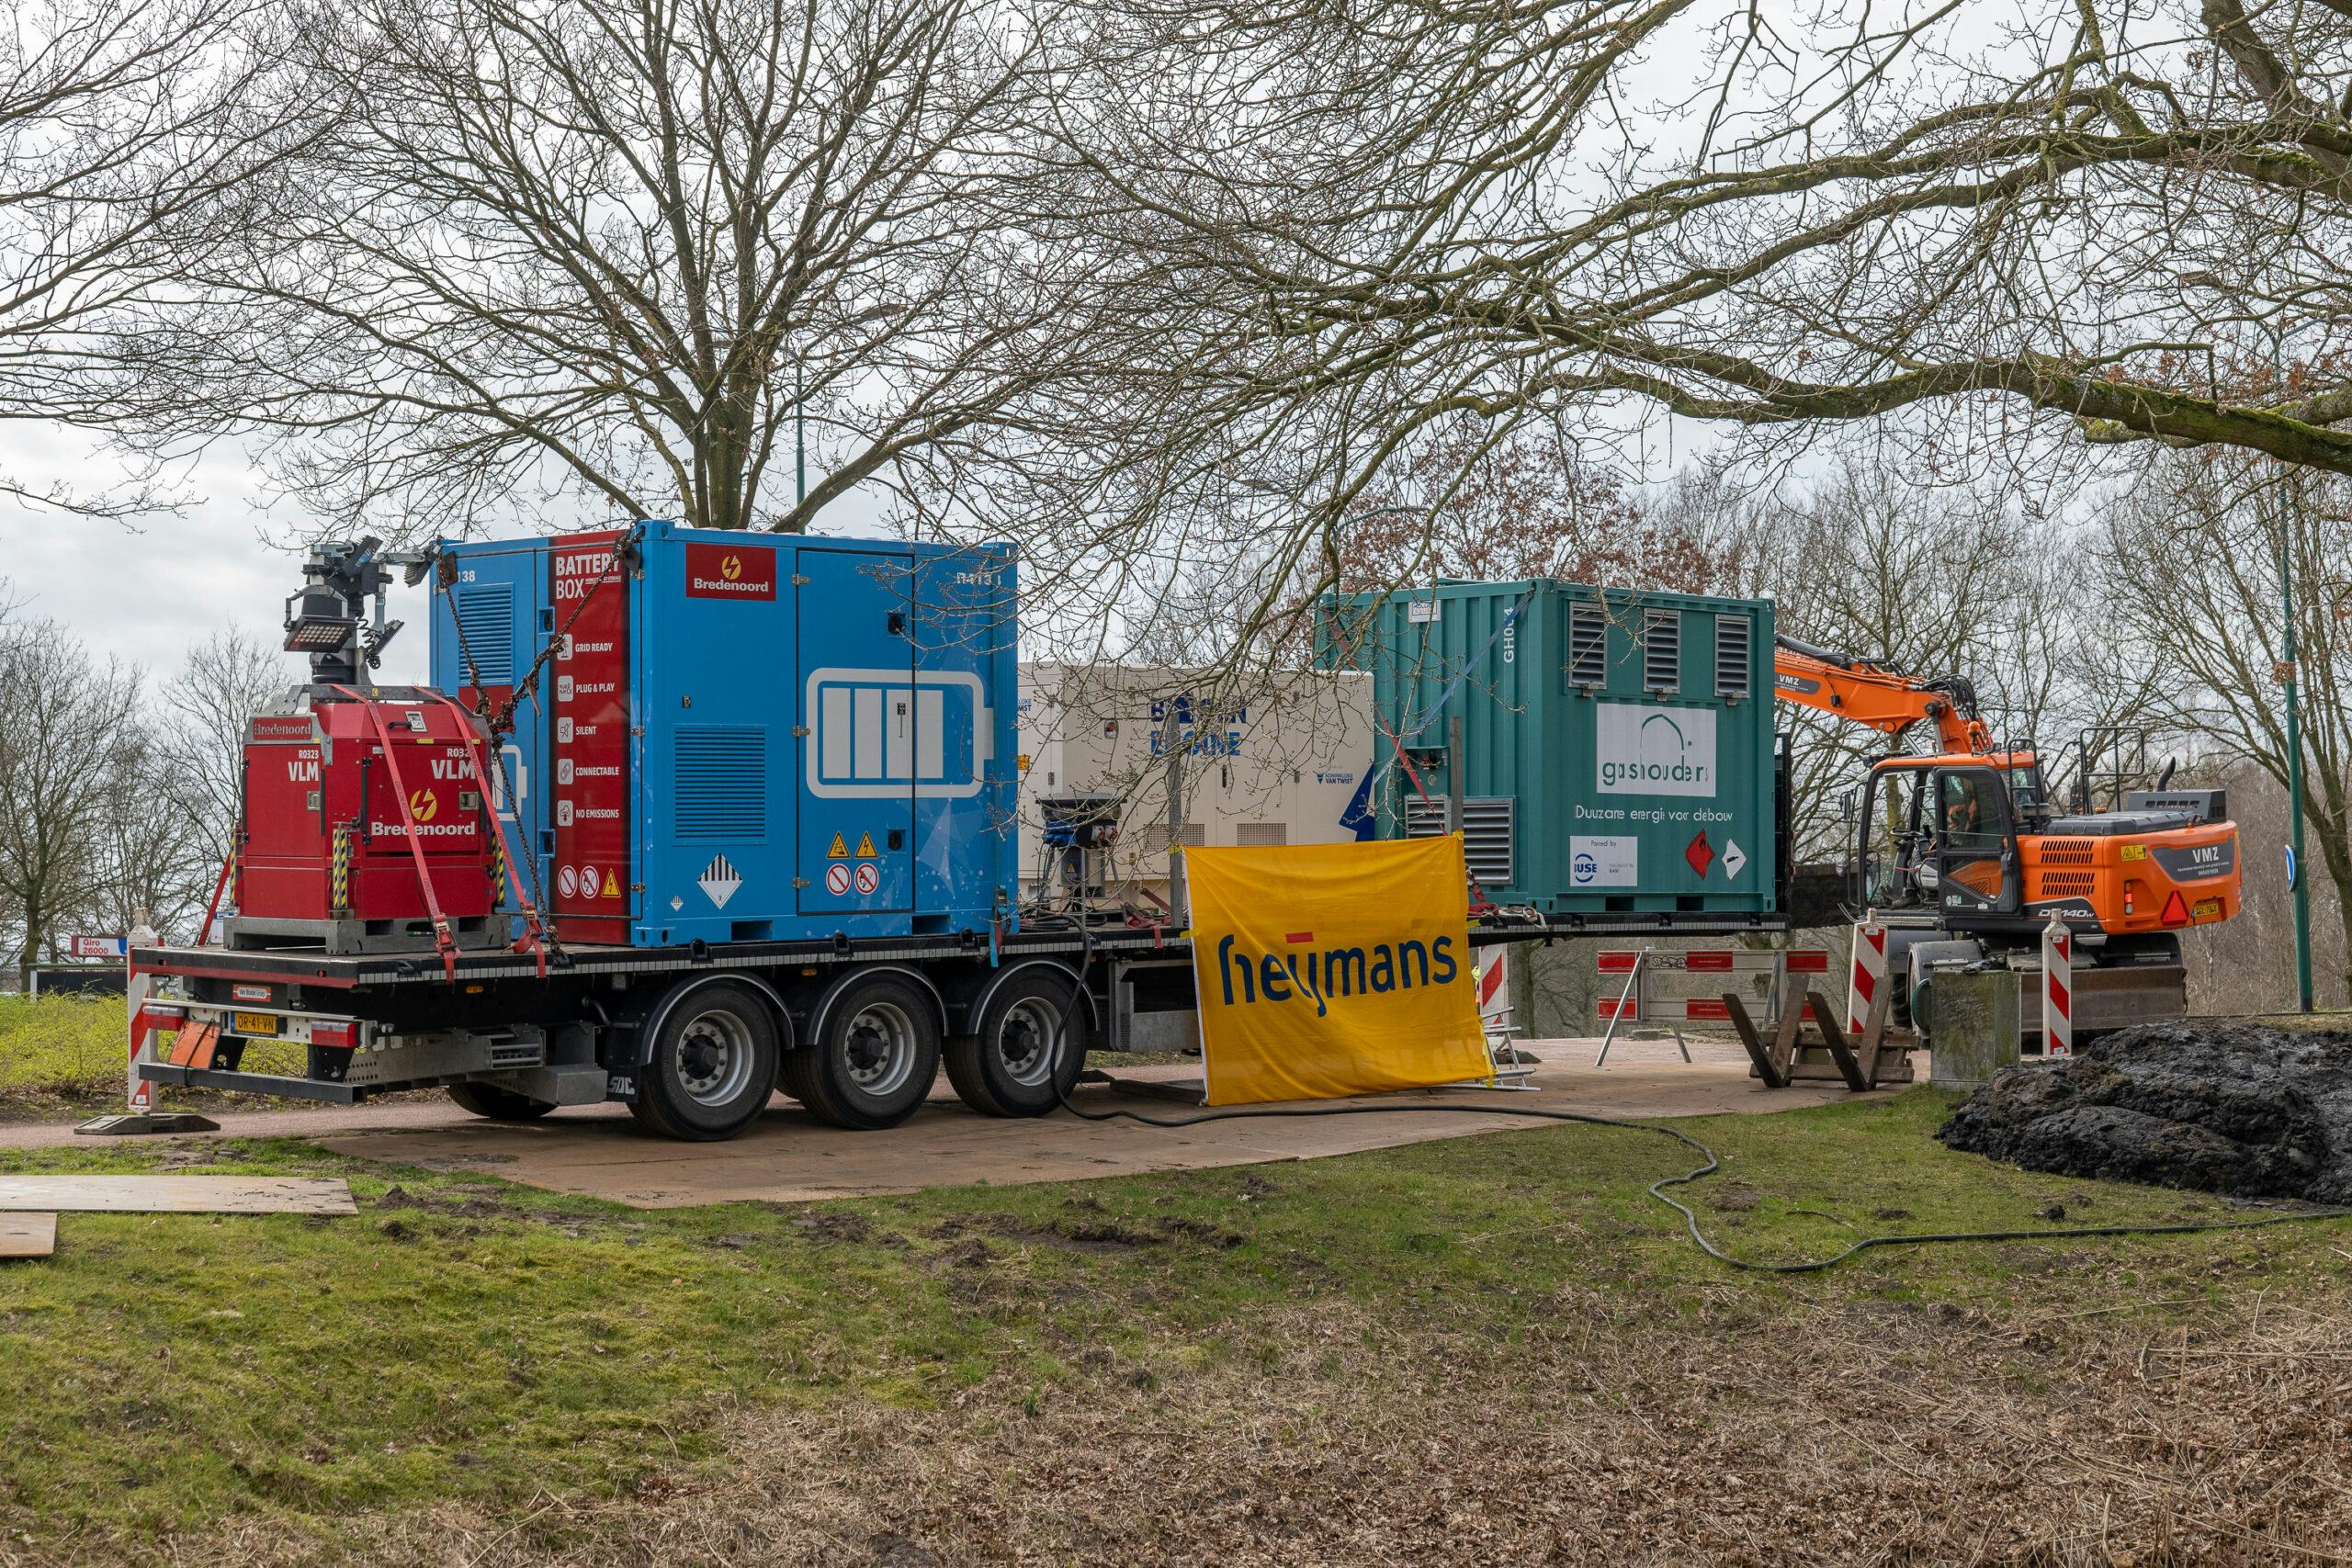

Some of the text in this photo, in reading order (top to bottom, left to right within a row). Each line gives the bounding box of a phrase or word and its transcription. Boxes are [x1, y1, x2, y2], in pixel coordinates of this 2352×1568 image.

[458, 570, 476, 582] 138
[556, 579, 584, 600] BOX
[694, 578, 769, 592] Bredenoord
[575, 642, 613, 652] GRID READY
[1779, 673, 1800, 686] VMZ
[575, 682, 615, 693] PLUG & PLAY
[254, 722, 311, 736] Bredenoord
[575, 726, 597, 735] SILENT
[1150, 729, 1240, 756] EGINE
[447, 748, 471, 758] R032
[288, 761, 320, 782] VLM
[431, 759, 476, 780] VLM
[575, 766, 619, 776] CONNECTABLE
[1601, 755, 1709, 786] gashouders
[575, 808, 619, 818] NO EMISSIONS
[1610, 840, 1617, 849] by
[2192, 846, 2220, 863] VMZ
[83, 938, 100, 946] Giro
[83, 947, 108, 955] 26000
[606, 1076, 636, 1095] SDC
